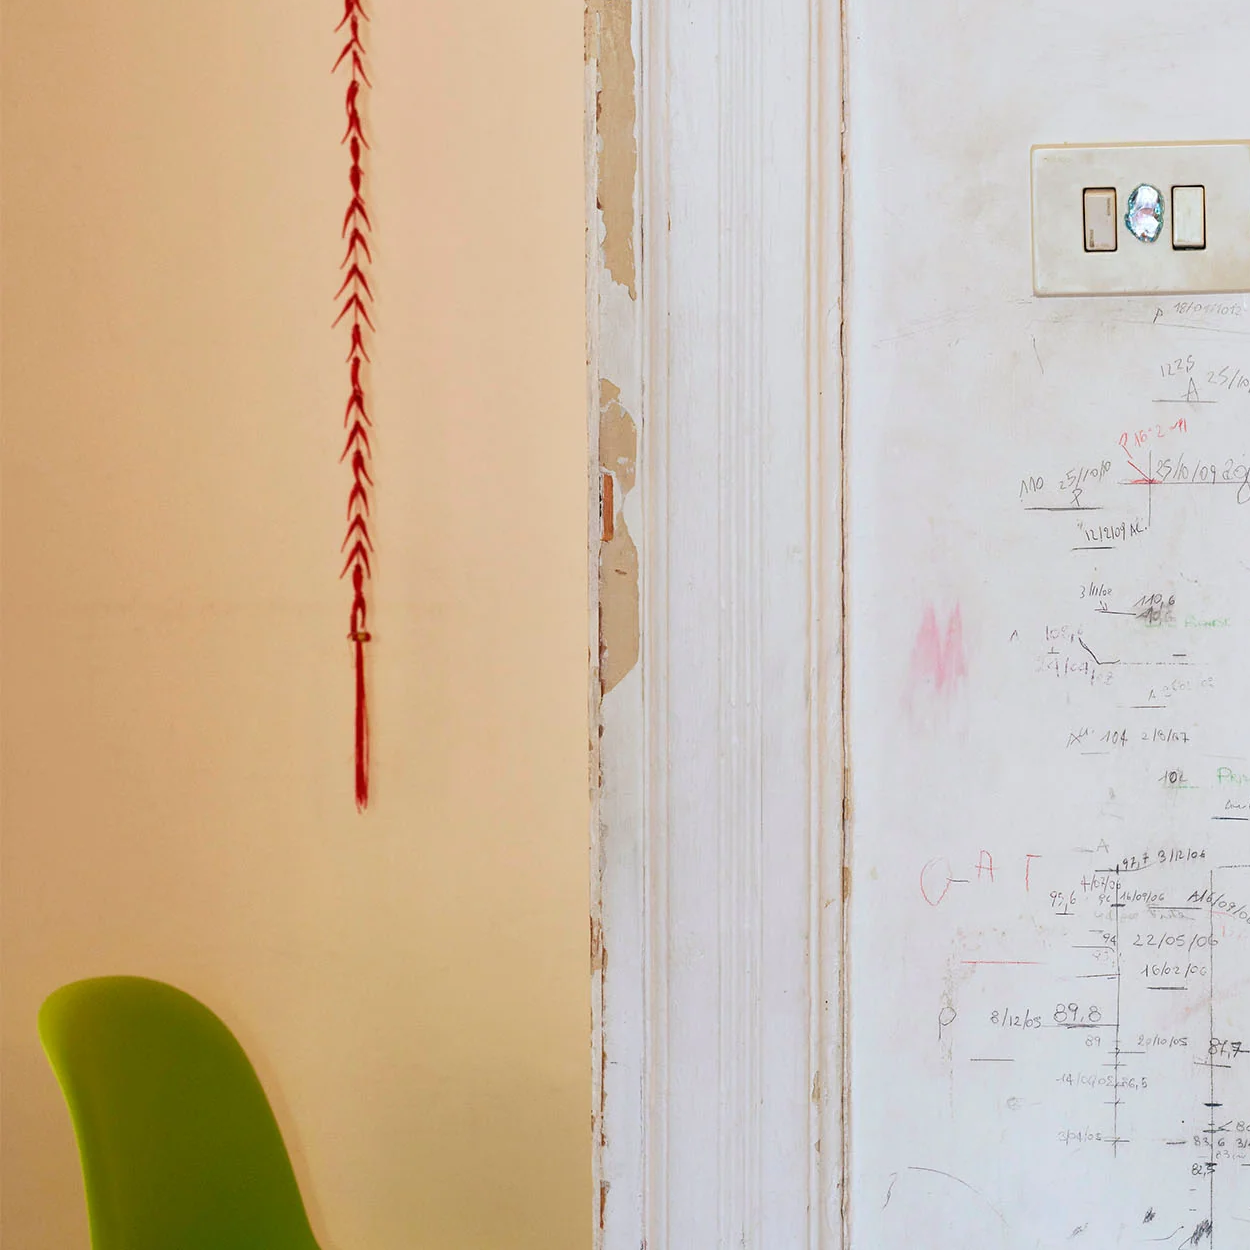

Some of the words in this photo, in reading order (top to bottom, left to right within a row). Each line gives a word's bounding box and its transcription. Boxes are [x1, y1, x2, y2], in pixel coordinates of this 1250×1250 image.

[1132, 931, 1219, 952] 22/05/06
[990, 1006, 1042, 1030] 8/12/05
[1053, 1002, 1102, 1024] 89,8
